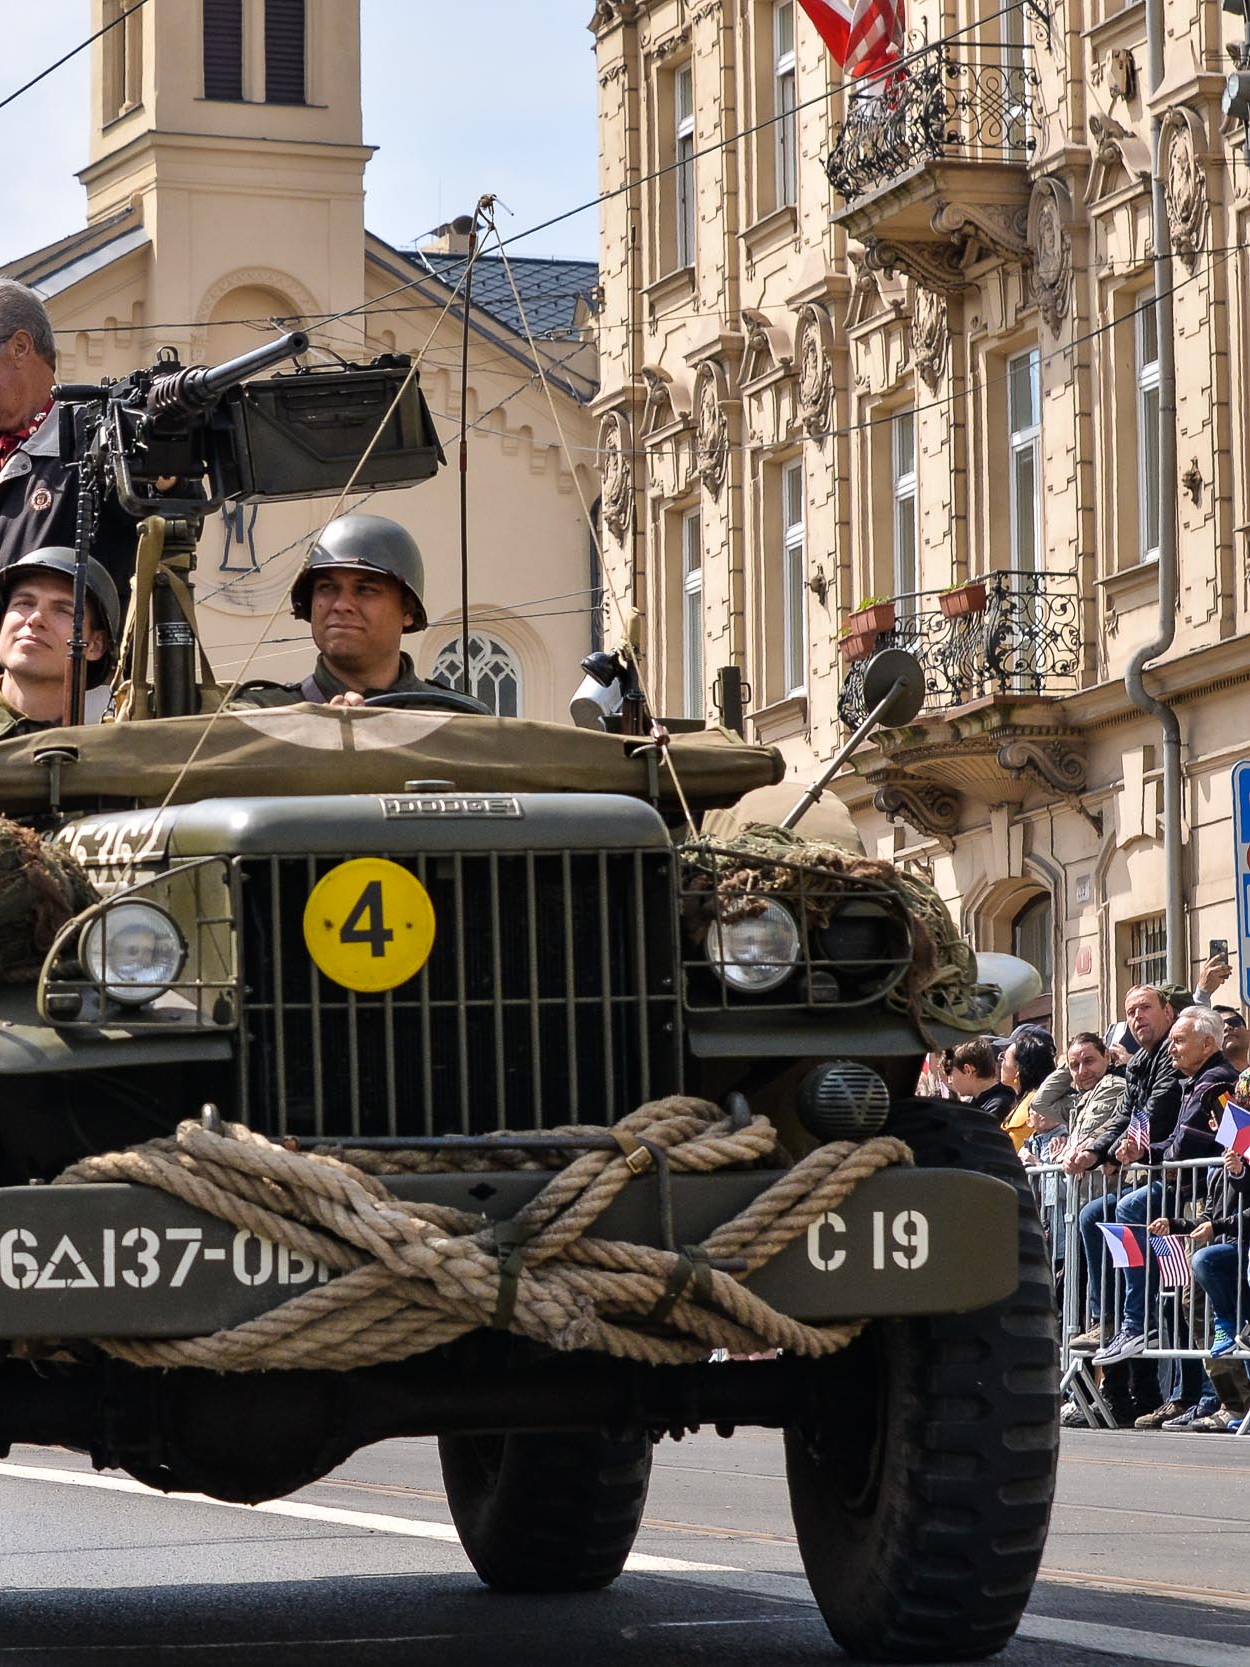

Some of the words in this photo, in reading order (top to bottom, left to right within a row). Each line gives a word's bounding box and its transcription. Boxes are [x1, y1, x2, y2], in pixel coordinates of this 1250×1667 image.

[394, 799, 512, 813] DODGE
[340, 880, 394, 958] 4
[807, 1211, 847, 1271] C
[873, 1210, 929, 1270] 19
